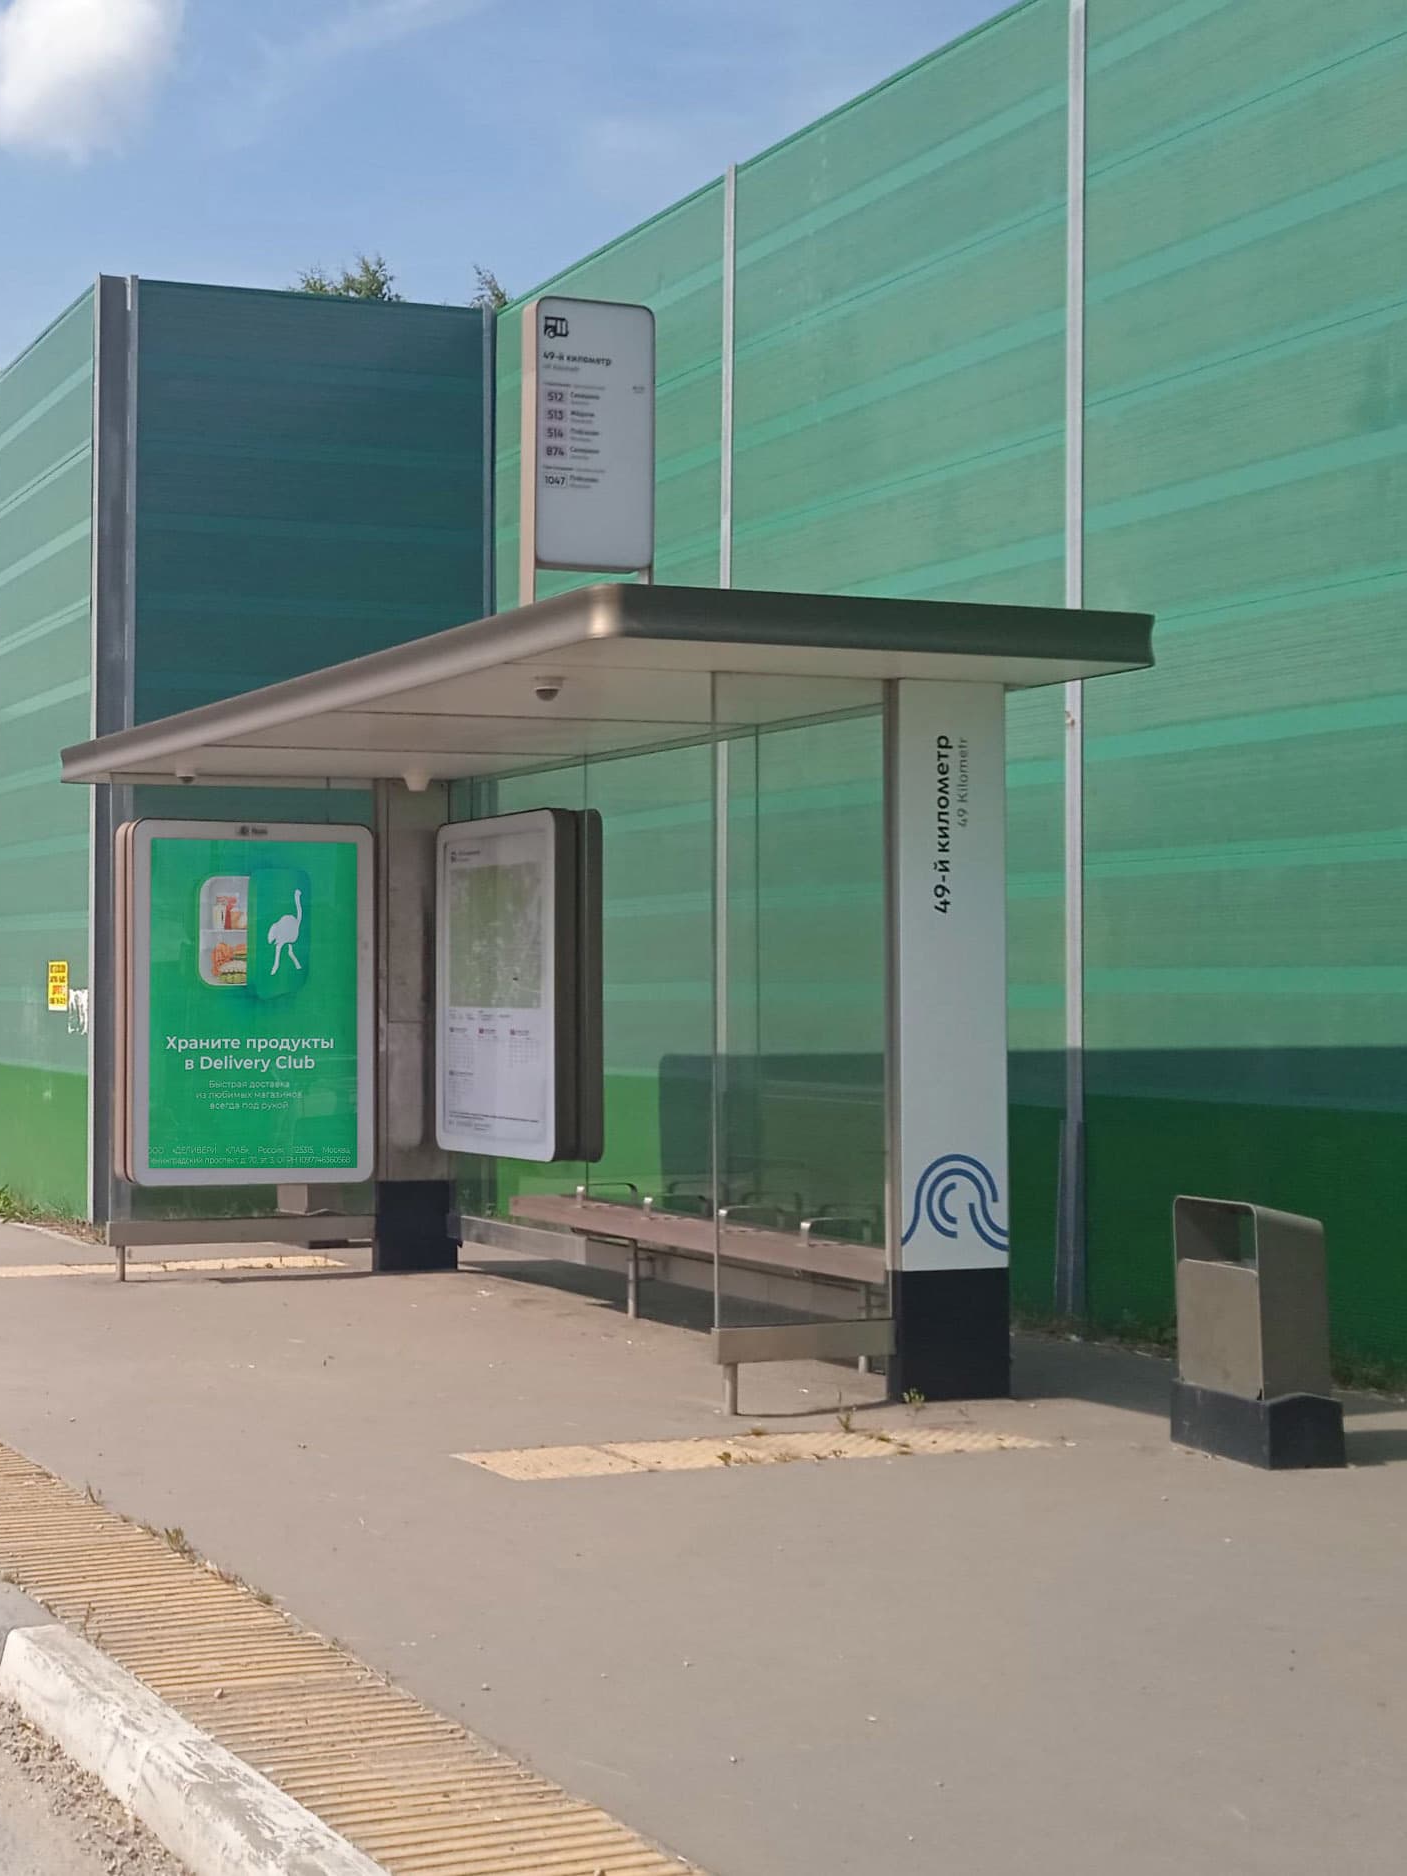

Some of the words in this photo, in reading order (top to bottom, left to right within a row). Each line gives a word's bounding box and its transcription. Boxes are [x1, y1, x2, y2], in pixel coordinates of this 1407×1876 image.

[566, 355, 612, 367] километр
[547, 391, 564, 402] 512
[547, 409, 564, 420] 513
[546, 427, 564, 439] 514
[546, 446, 565, 457] 874
[545, 475, 566, 486] 1047
[957, 737, 970, 804] Kilometr
[936, 734, 953, 853] километр
[956, 808, 969, 828] 49
[933, 859, 951, 914] 49-й
[165, 1035, 241, 1053] Храните
[246, 1037, 335, 1053] продукты
[184, 1058, 195, 1070] в
[199, 1055, 271, 1072] Delivery
[275, 1055, 316, 1070] Club
[208, 1079, 247, 1090] Быстрая
[249, 1080, 291, 1090] доставка
[209, 1102, 240, 1111] всегда
